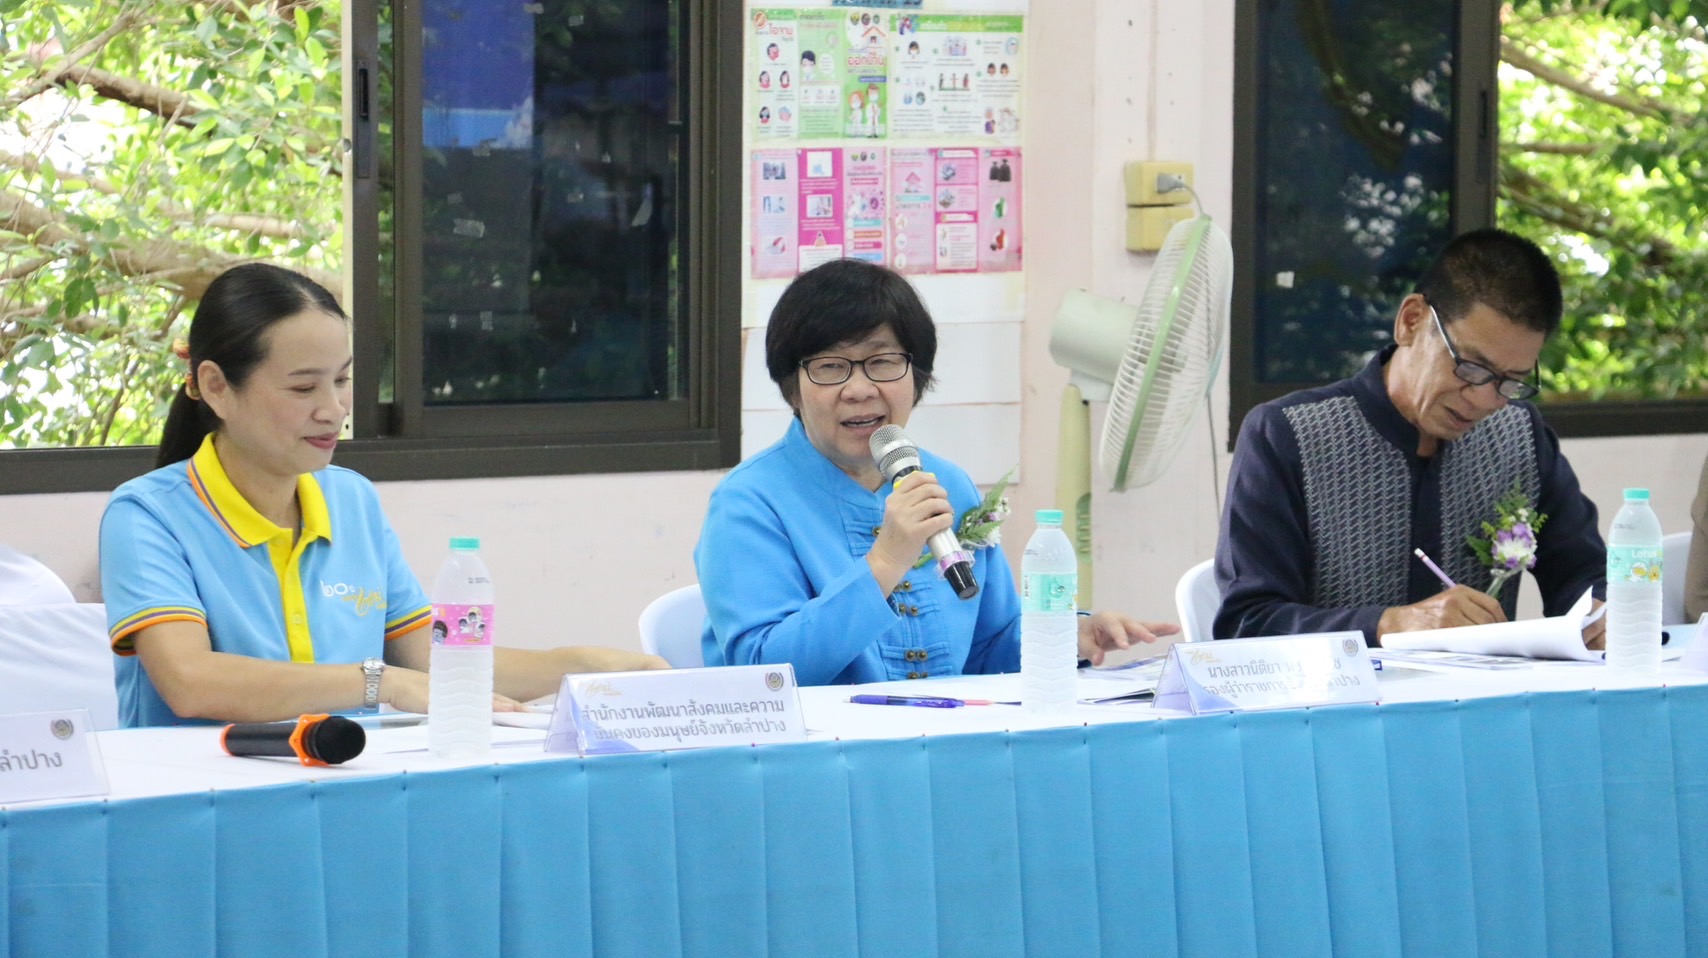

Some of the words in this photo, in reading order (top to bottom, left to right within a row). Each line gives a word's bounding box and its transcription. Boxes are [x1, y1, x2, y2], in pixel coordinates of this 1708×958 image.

[581, 699, 785, 722] สำนักงานพัฒนาสังคมและความ
